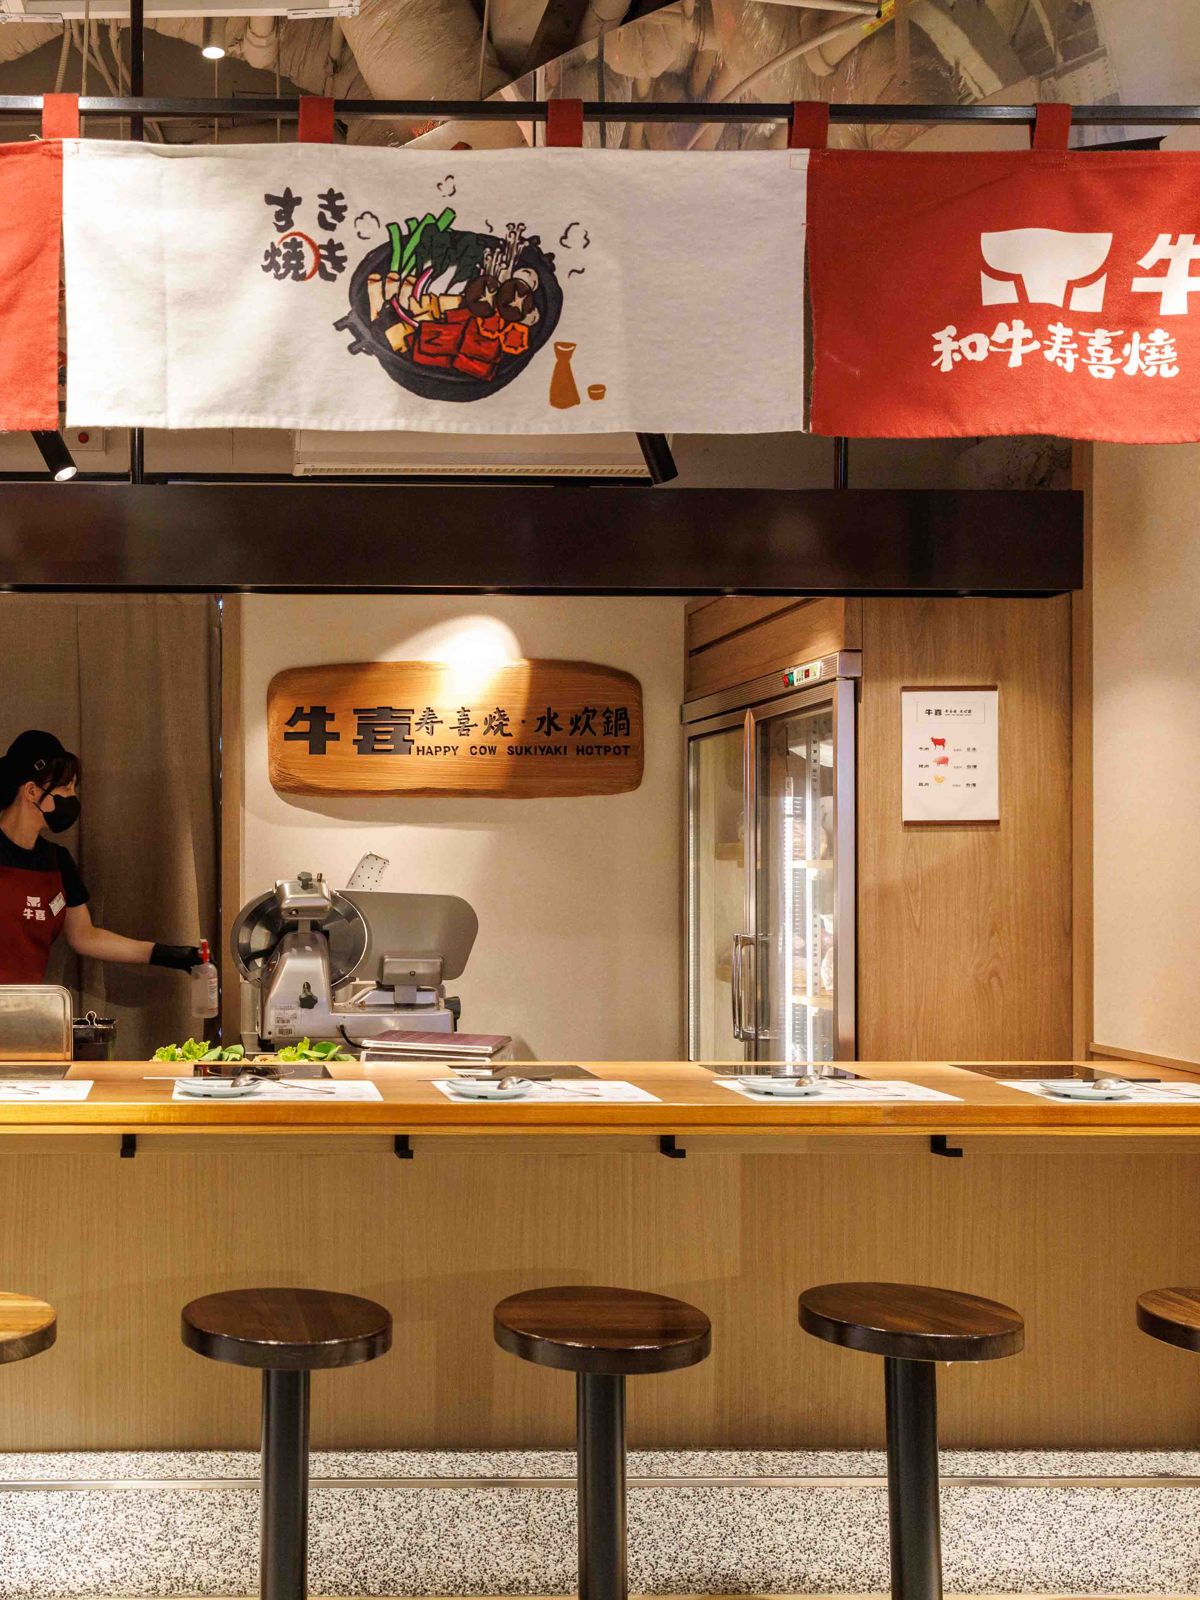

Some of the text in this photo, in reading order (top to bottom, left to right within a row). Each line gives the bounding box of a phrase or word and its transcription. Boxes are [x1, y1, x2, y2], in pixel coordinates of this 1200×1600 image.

[264, 187, 348, 232] すき
[262, 237, 348, 283] 焼き
[284, 706, 415, 756] 牛喜
[416, 745, 631, 756] HAPPY COW SUKIYAKI HOTPOT
